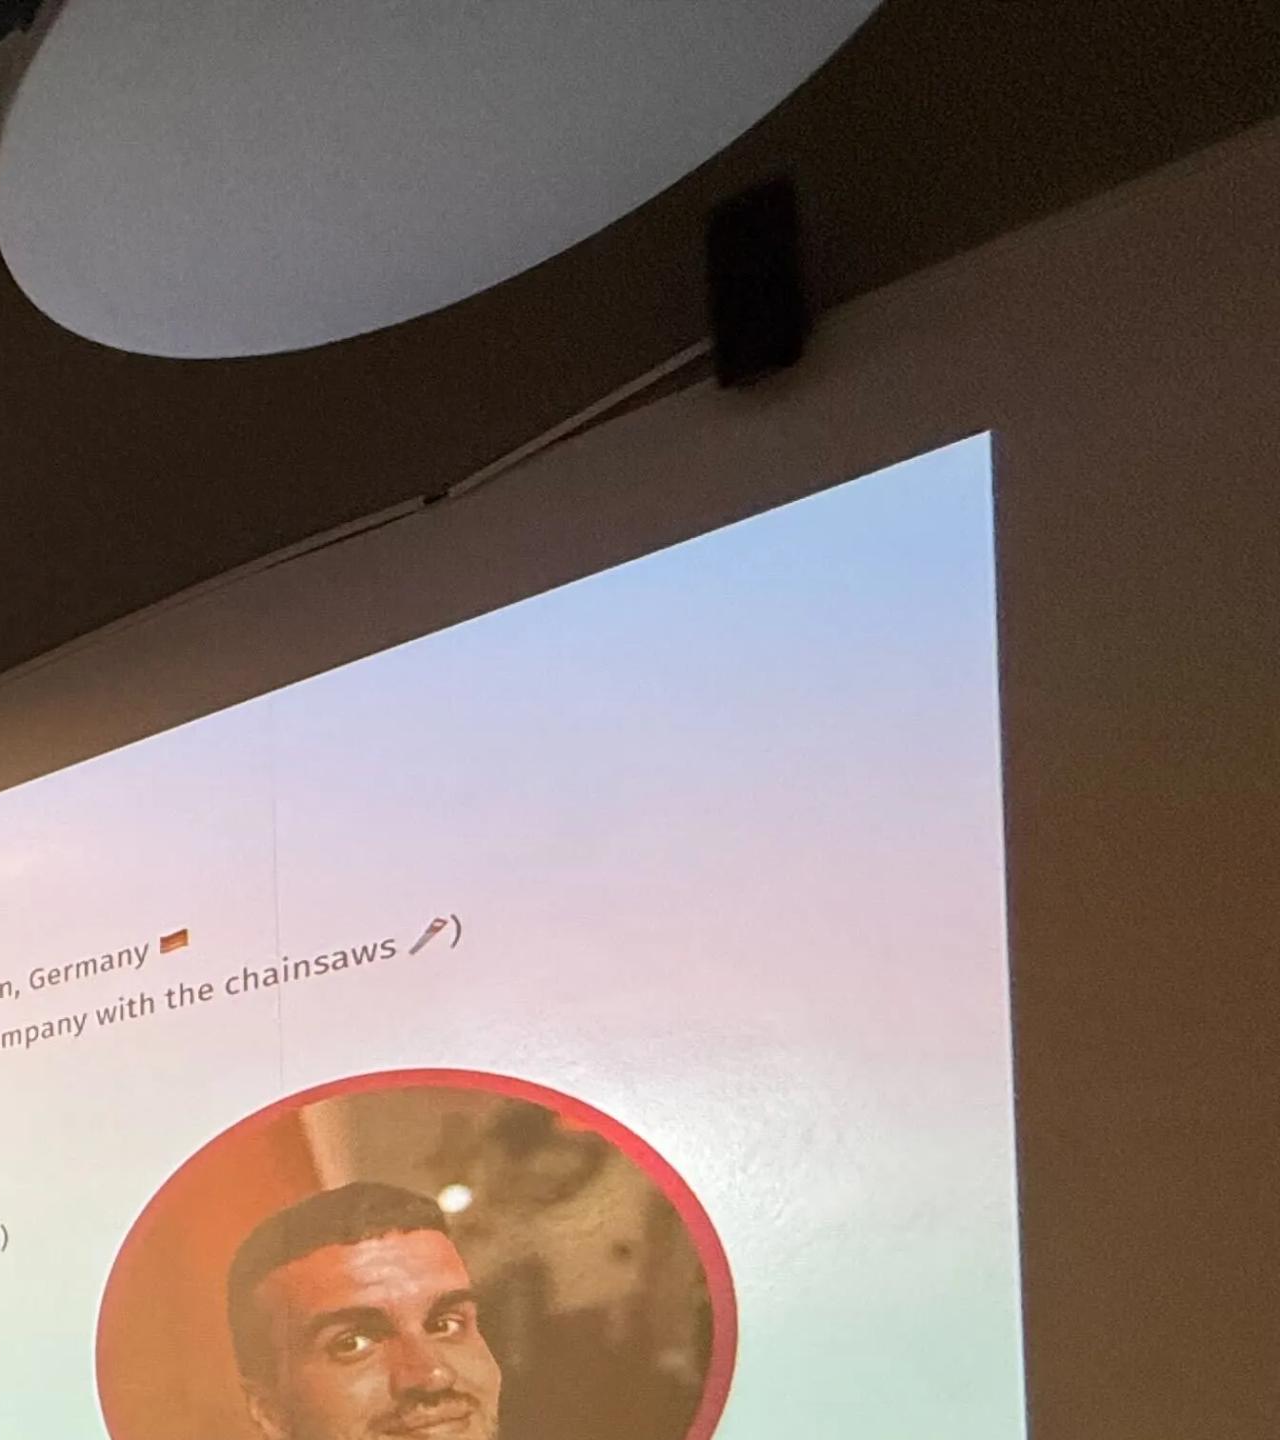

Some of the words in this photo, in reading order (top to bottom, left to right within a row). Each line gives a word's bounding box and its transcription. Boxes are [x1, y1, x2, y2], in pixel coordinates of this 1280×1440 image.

[29, 943, 149, 990] Germany
[96, 992, 155, 1026] with
[164, 982, 214, 1009] the
[225, 938, 397, 995] chainsaws
